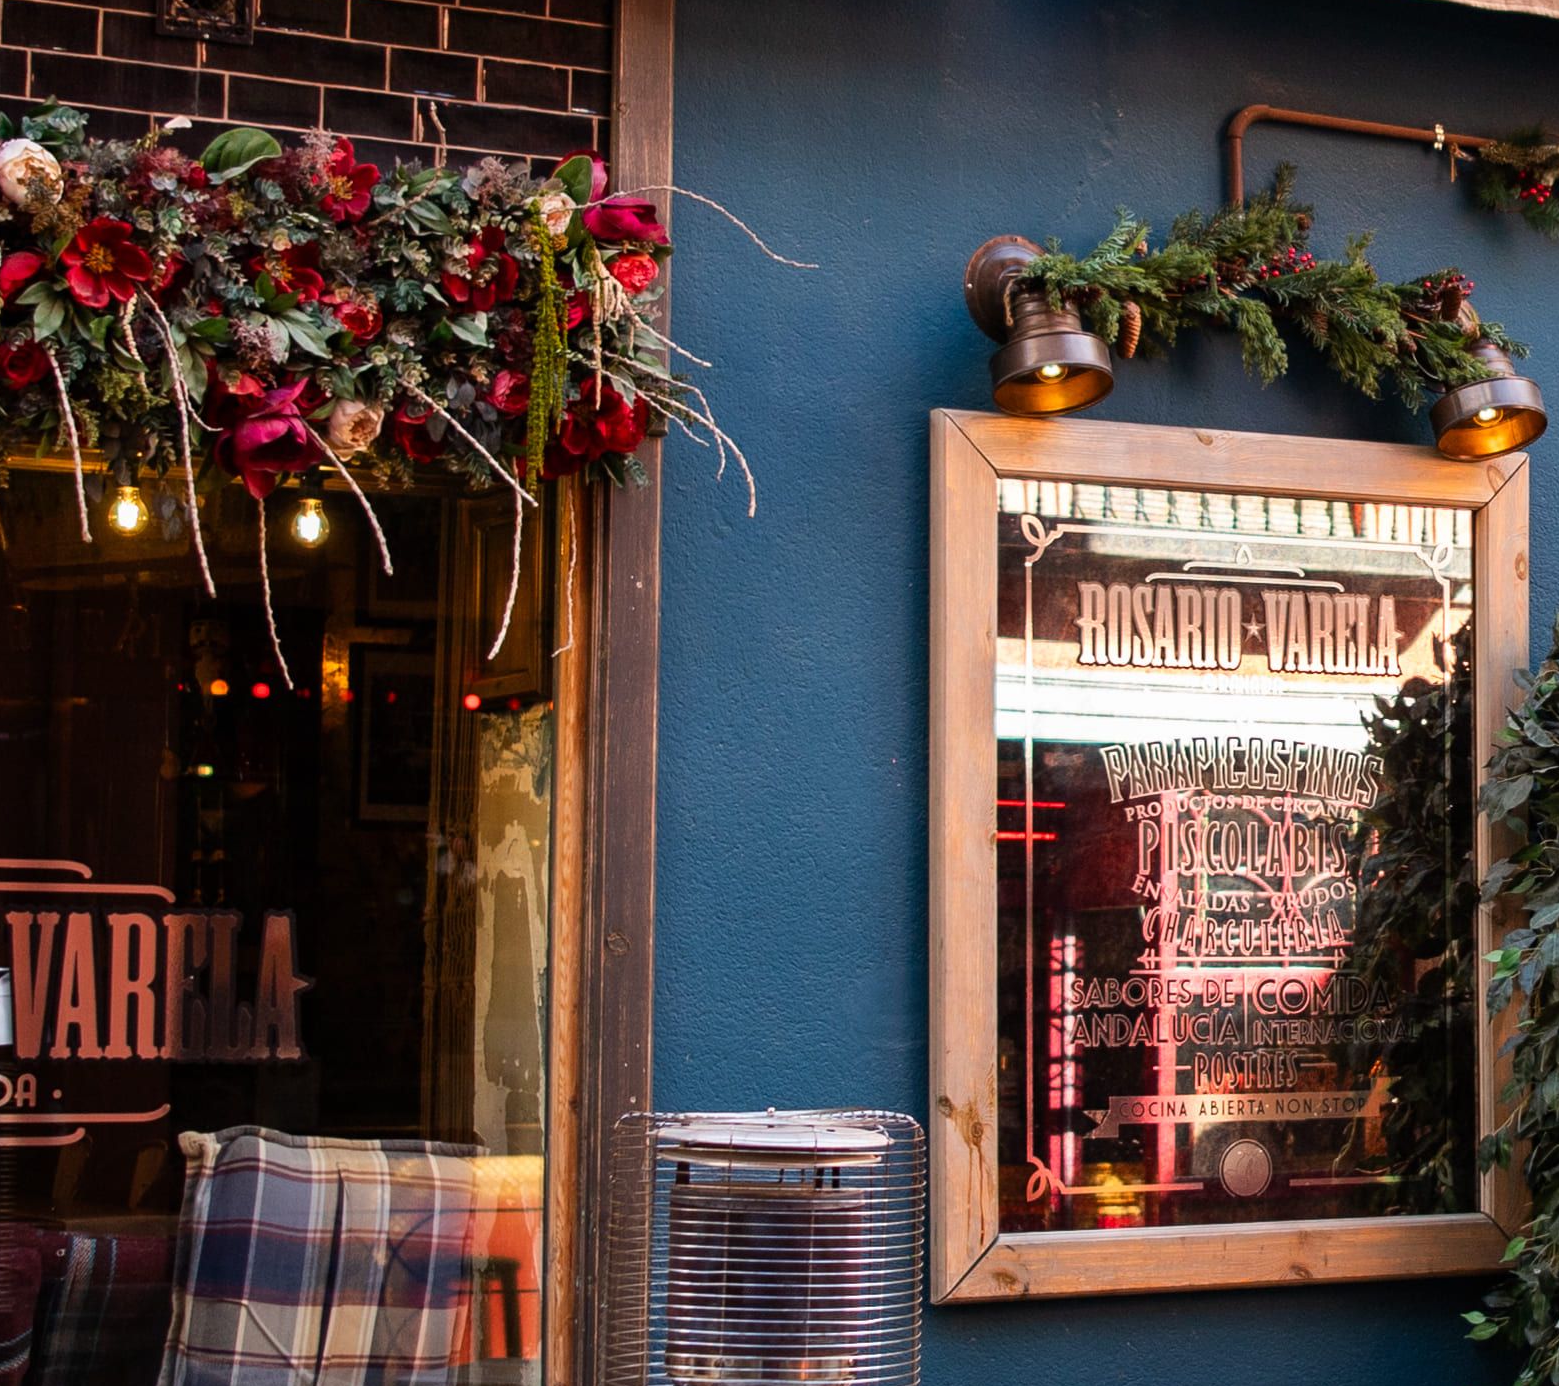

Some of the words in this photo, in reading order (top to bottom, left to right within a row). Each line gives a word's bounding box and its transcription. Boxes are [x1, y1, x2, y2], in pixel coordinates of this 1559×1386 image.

[1075, 581, 1242, 671] ROSARIO
[1261, 590, 1405, 676] VARELA
[1099, 736, 1384, 809] PARAPICOSFINOS
[1125, 795, 1236, 822] PRODUCTOS
[1241, 796, 1266, 811] DE
[1138, 819, 1349, 877] PISCOLABIS
[1131, 874, 1250, 912] ENSALADAS
[1270, 877, 1357, 912] CRUDOS
[5, 908, 314, 1062] VARELA
[1069, 977, 1192, 1009] SABORES
[1202, 978, 1235, 1007] DE
[1253, 975, 1392, 1015] COMIDA
[1069, 1008, 1240, 1047] ANDALUCÍA
[1253, 1017, 1420, 1046] INTERNACIONAL
[1194, 1050, 1299, 1089] POSTRES
[1119, 1100, 1188, 1118] COCINA
[1199, 1099, 1266, 1116] ABIERTA
[1275, 1097, 1313, 1115] NON
[1322, 1097, 1366, 1114] STOP
